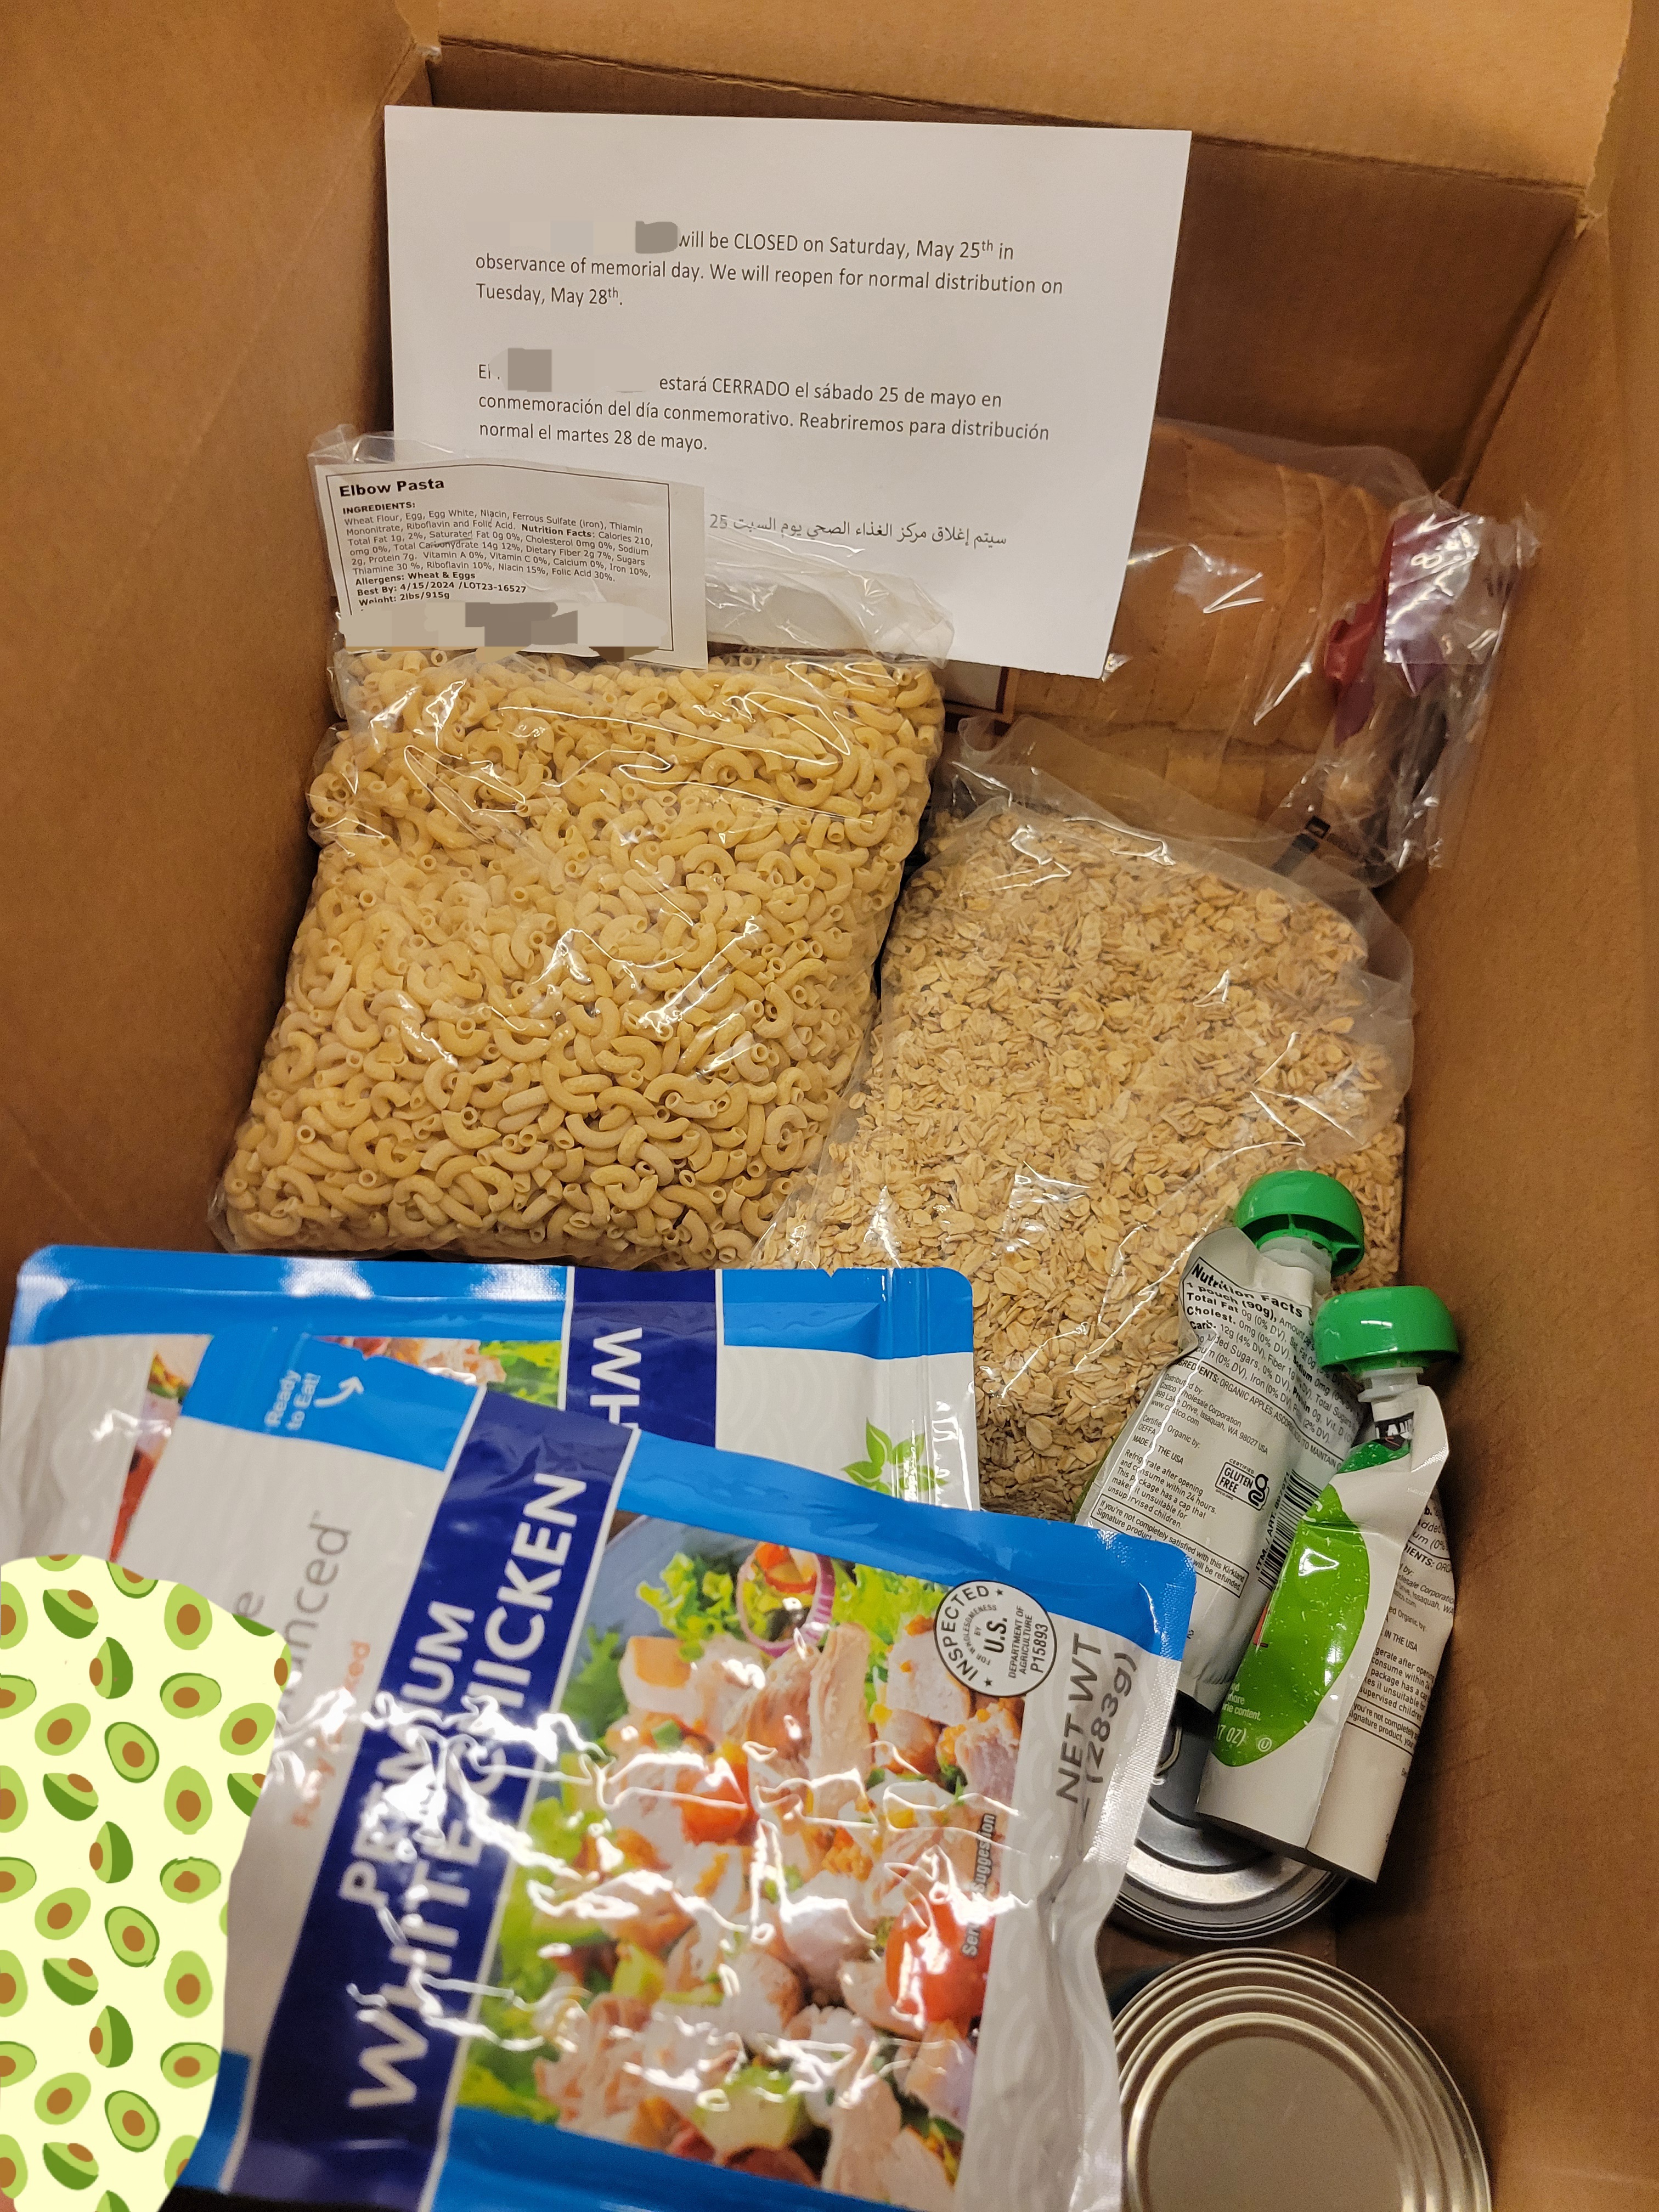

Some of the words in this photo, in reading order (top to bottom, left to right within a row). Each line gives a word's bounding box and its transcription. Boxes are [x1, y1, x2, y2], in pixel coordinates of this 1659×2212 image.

[679, 230, 704, 248] will
[710, 231, 729, 249] be
[735, 233, 798, 251] CLOSED
[804, 240, 823, 252] on
[830, 236, 909, 259] Saturday,
[917, 240, 954, 262] May
[960, 239, 993, 258] 25th
[999, 242, 1013, 259] in
[476, 253, 565, 273] observance
[571, 257, 586, 273] of
[591, 253, 665, 277] memorial
[672, 261, 703, 283] day.
[710, 263, 736, 280] We
[742, 264, 769, 281] will
[775, 270, 832, 287] reopen
[839, 268, 864, 285] for
[869, 272, 929, 289] normal
[935, 272, 1035, 293] distribution
[1042, 281, 1062, 294] on
[476, 283, 545, 305] Tuesday,
[551, 287, 584, 307] May
[659, 376, 706, 392] estará
[713, 378, 789, 397] CERRADO
[795, 382, 808, 398] el
[814, 383, 873, 401] sábado
[879, 387, 898, 402] 25
[905, 387, 924, 403] de
[931, 393, 975, 409] mayo
[981, 395, 1001, 407] en
[479, 397, 602, 415] conmemoración
[608, 400, 630, 416] del
[636, 402, 658, 418] día
[664, 408, 793, 426] conmemorativo.
[800, 413, 903, 432] Reabriremos
[910, 421, 945, 436] para
[952, 419, 1048, 440] distribución
[480, 424, 533, 438] normal
[539, 425, 551, 439] el
[557, 429, 608, 443] martes
[614, 430, 632, 445] 28
[637, 431, 655, 447] de
[662, 437, 707, 453] mayo.
[339, 484, 391, 498] Elbow
[397, 478, 445, 492] Pasta
[343, 501, 416, 515] INGREDIENTS:
[448, 510, 477, 518] White,
[481, 510, 510, 520] Niacin,
[513, 512, 544, 523] Ferrous
[546, 516, 576, 526] Sulfate
[609, 522, 643, 533] Thiamin
[781, 522, 802, 538] يوم
[806, 521, 850, 540] الصحي
[855, 521, 893, 537] الغذاء
[896, 522, 927, 543] مركز
[347, 524, 403, 535] Mononitrate,
[407, 521, 450, 530] Riboflavin
[495, 521, 515, 529] Acid.
[522, 524, 563, 535] Nutrition
[567, 529, 595, 538] Facts:
[599, 532, 631, 543] Calories
[634, 537, 653, 547] 210,
[348, 537, 370, 546] Total
[430, 530, 472, 538] Saturated
[493, 532, 503, 540] 0g
[506, 533, 523, 542] 0%,
[526, 535, 573, 546] Cholesterol
[576, 540, 595, 549] 0mg
[599, 541, 616, 551] 0%,
[618, 544, 648, 556] Sodium
[932, 526, 969, 546] إغلاق
[974, 532, 1007, 549] سيتم
[356, 575, 405, 586] Allergens:
[408, 572, 439, 580] Wheat
[453, 572, 476, 580] Eggs
[357, 588, 379, 596] Best
[382, 586, 397, 594] By:
[400, 582, 455, 591] 4/15/2024
[399, 591, 450, 601] 2lbs/915g
[1192, 1263, 1255, 1299] Nutrition
[1260, 1294, 1302, 1318] Facts
[1187, 1292, 1216, 1305] Total
[1221, 1301, 1239, 1313] Fat
[1187, 1306, 1236, 1325] Cholest.
[1220, 1379, 1250, 1401] ORGANIC
[1249, 1396, 1273, 1417] APPLES,
[1208, 1404, 1242, 1427] Corporation
[1167, 1425, 1192, 1443] Organic
[1182, 1400, 1198, 1416] Drive,
[1200, 1410, 1226, 1431] Issaquah,
[1228, 1425, 1238, 1437] WA
[1239, 1432, 1258, 1447] 98027
[1258, 1442, 1268, 1455] USA
[1158, 1445, 1171, 1457] THE
[1171, 1453, 1184, 1465] USA
[1229, 1458, 1254, 1474] CERTIFIED
[1161, 1467, 1178, 1480] after
[1178, 1476, 1204, 1496] opening
[1219, 1477, 1239, 1493] FREE
[1224, 1467, 1254, 1489] GLUTEN
[1166, 1481, 1186, 1497] within
[1186, 1491, 1195, 1502] 24
[1197, 1495, 1217, 1514] hours.
[1154, 1506, 1182, 1530] children.
[1136, 1518, 1169, 1541] completely
[1197, 1550, 1209, 1562] with
[941, 1585, 989, 1681] INSPECTED
[984, 1617, 1007, 1653] U.S.
[1008, 1619, 1023, 1679] DEPARTMENT
[1016, 1605, 1024, 1617] OF
[1019, 1614, 1032, 1674] AGRICULTURE
[1393, 1634, 1404, 1645] THE
[1406, 1639, 1418, 1652] USA
[1030, 1623, 1048, 1673] P15893
[1069, 1632, 1101, 1701] WT
[1404, 1672, 1424, 1687] within
[1384, 1685, 1423, 1707] unsuitable
[1086, 1652, 1136, 1783] (283g)
[1056, 1712, 1084, 1804] NET
